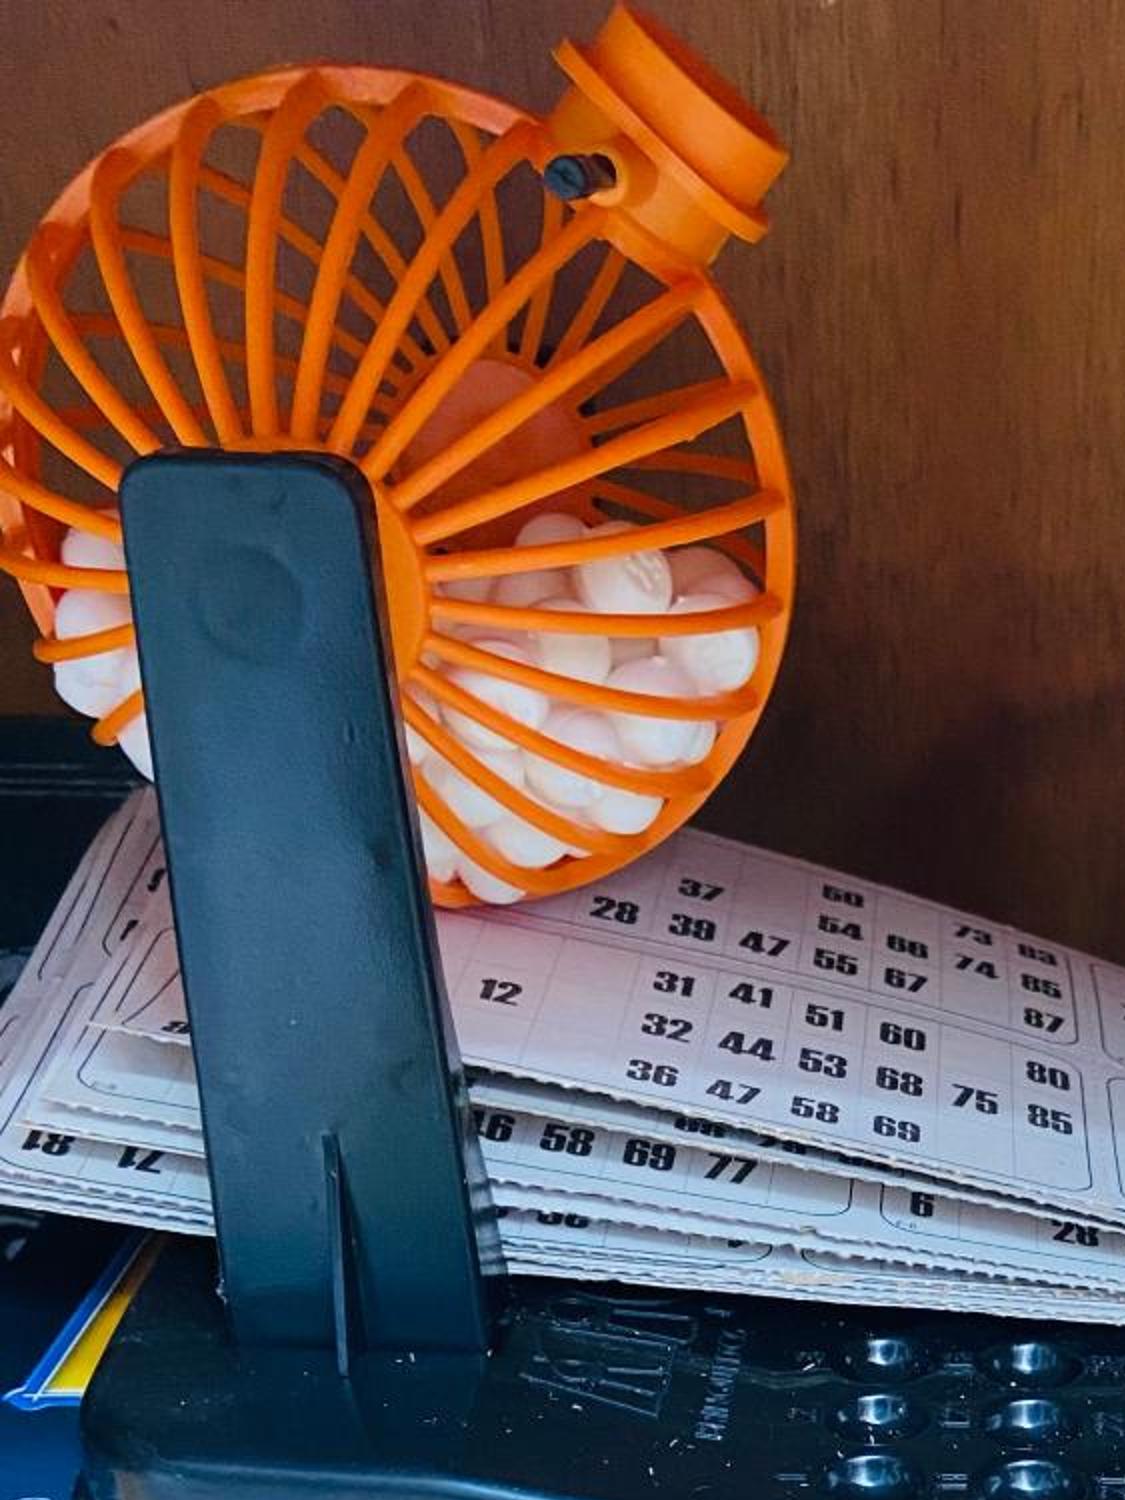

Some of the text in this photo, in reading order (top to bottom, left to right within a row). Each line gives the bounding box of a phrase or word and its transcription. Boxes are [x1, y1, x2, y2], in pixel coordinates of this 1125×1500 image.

[589, 896, 640, 925] 28
[738, 930, 790, 957] 47
[813, 947, 859, 976] 55
[884, 967, 928, 993] 67
[1023, 1007, 1065, 1034] 87
[678, 877, 725, 901] 37
[817, 914, 864, 941] 54
[955, 952, 1000, 979] 74
[1020, 973, 1063, 999] 85
[954, 924, 993, 946] 73
[479, 978, 1073, 1135] 12 32 44 53 68 75 85
[653, 971, 1071, 1091] 31 41 51 60 80
[626, 1059, 921, 1143] 36 47 58 69
[539, 1122, 597, 1157] 58
[622, 1138, 676, 1172] 69
[703, 1152, 760, 1185] 77
[909, 1191, 935, 1218] 6
